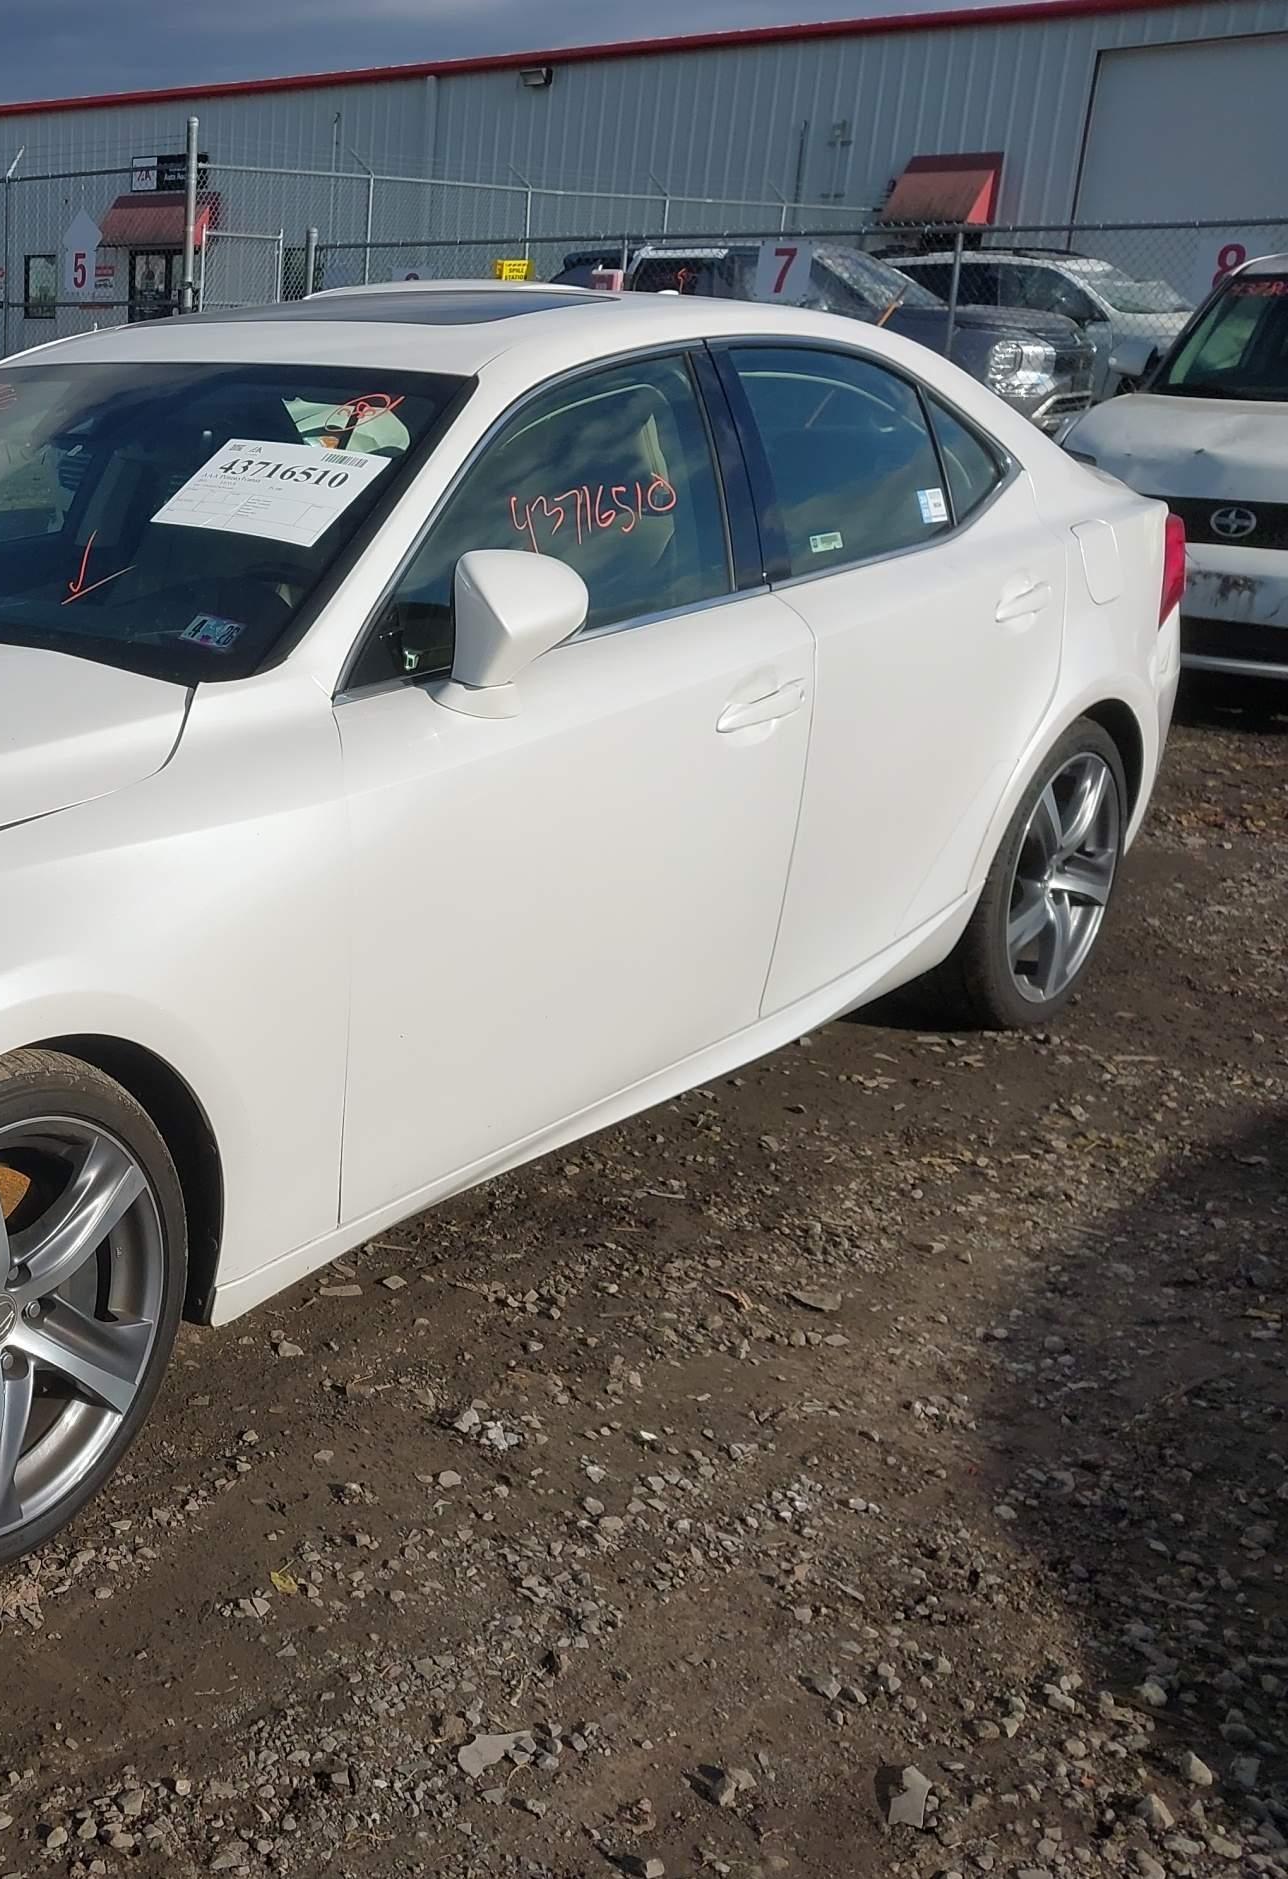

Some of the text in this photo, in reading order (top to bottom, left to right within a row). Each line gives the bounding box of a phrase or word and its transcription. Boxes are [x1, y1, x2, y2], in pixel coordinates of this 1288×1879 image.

[73, 252, 87, 289] 5
[774, 247, 798, 294] 7
[218, 458, 350, 489] 43716510
[509, 472, 677, 554] 43716510
